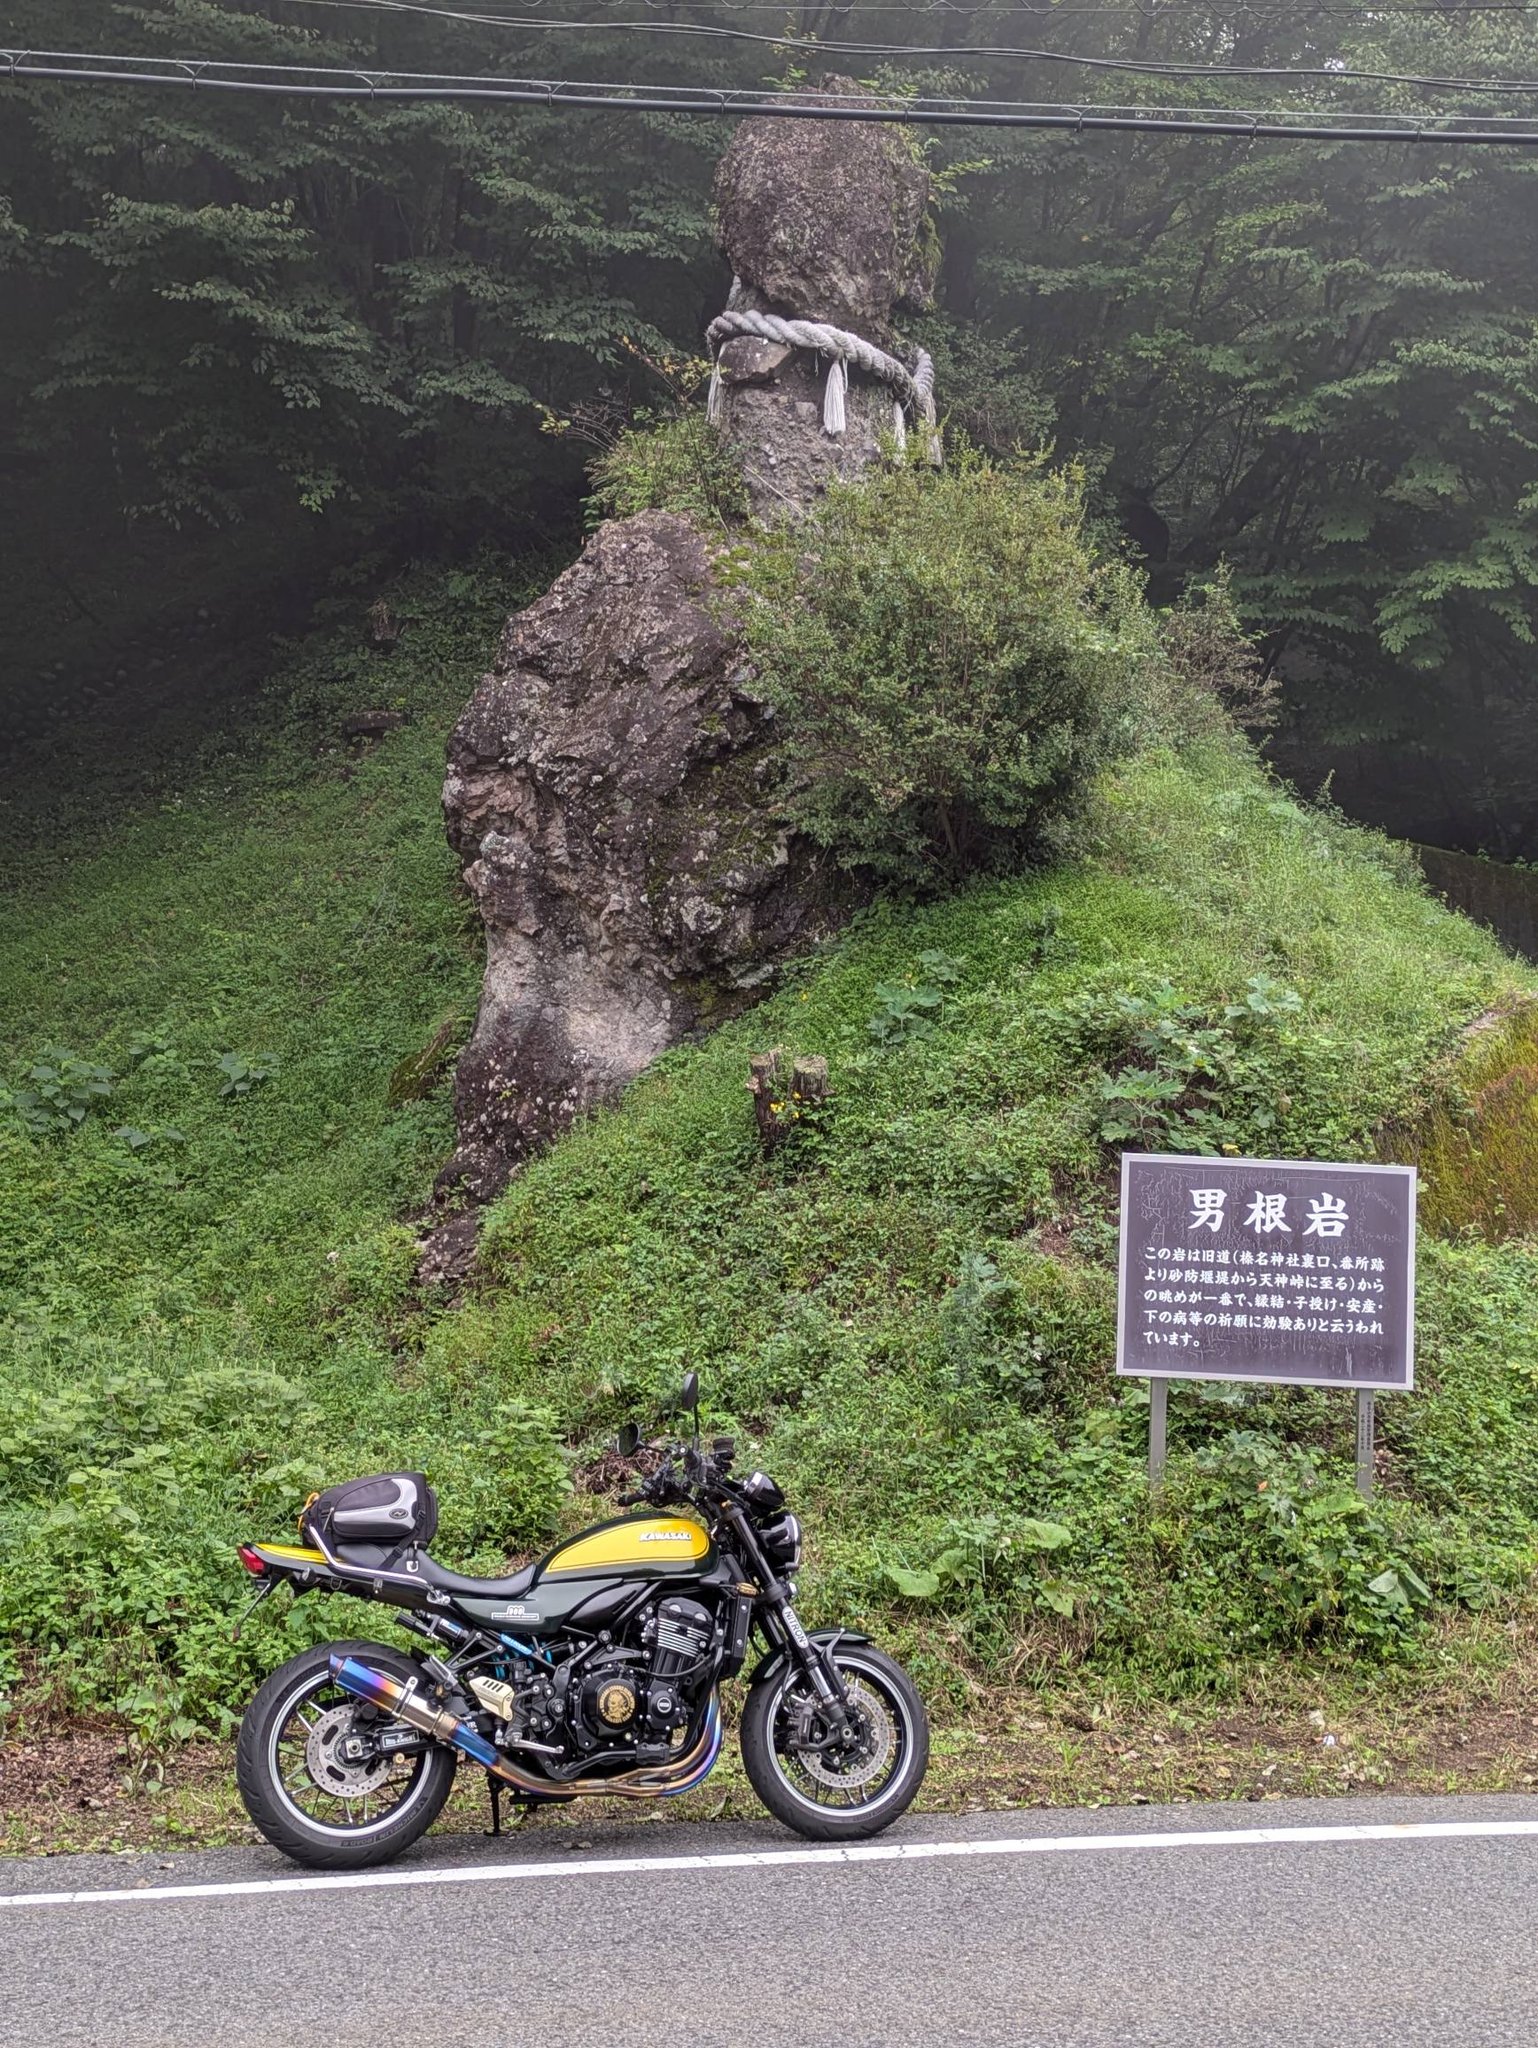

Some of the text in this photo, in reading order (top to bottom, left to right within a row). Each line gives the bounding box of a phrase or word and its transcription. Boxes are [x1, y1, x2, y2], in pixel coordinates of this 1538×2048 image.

[1188, 1188, 1349, 1237] 男根岩
[1143, 1309, 1385, 1335] 下の病等の祈願に効験ありと云うわれ
[1142, 1330, 1201, 1349] ています。
[784, 1610, 807, 1643] NITRON
